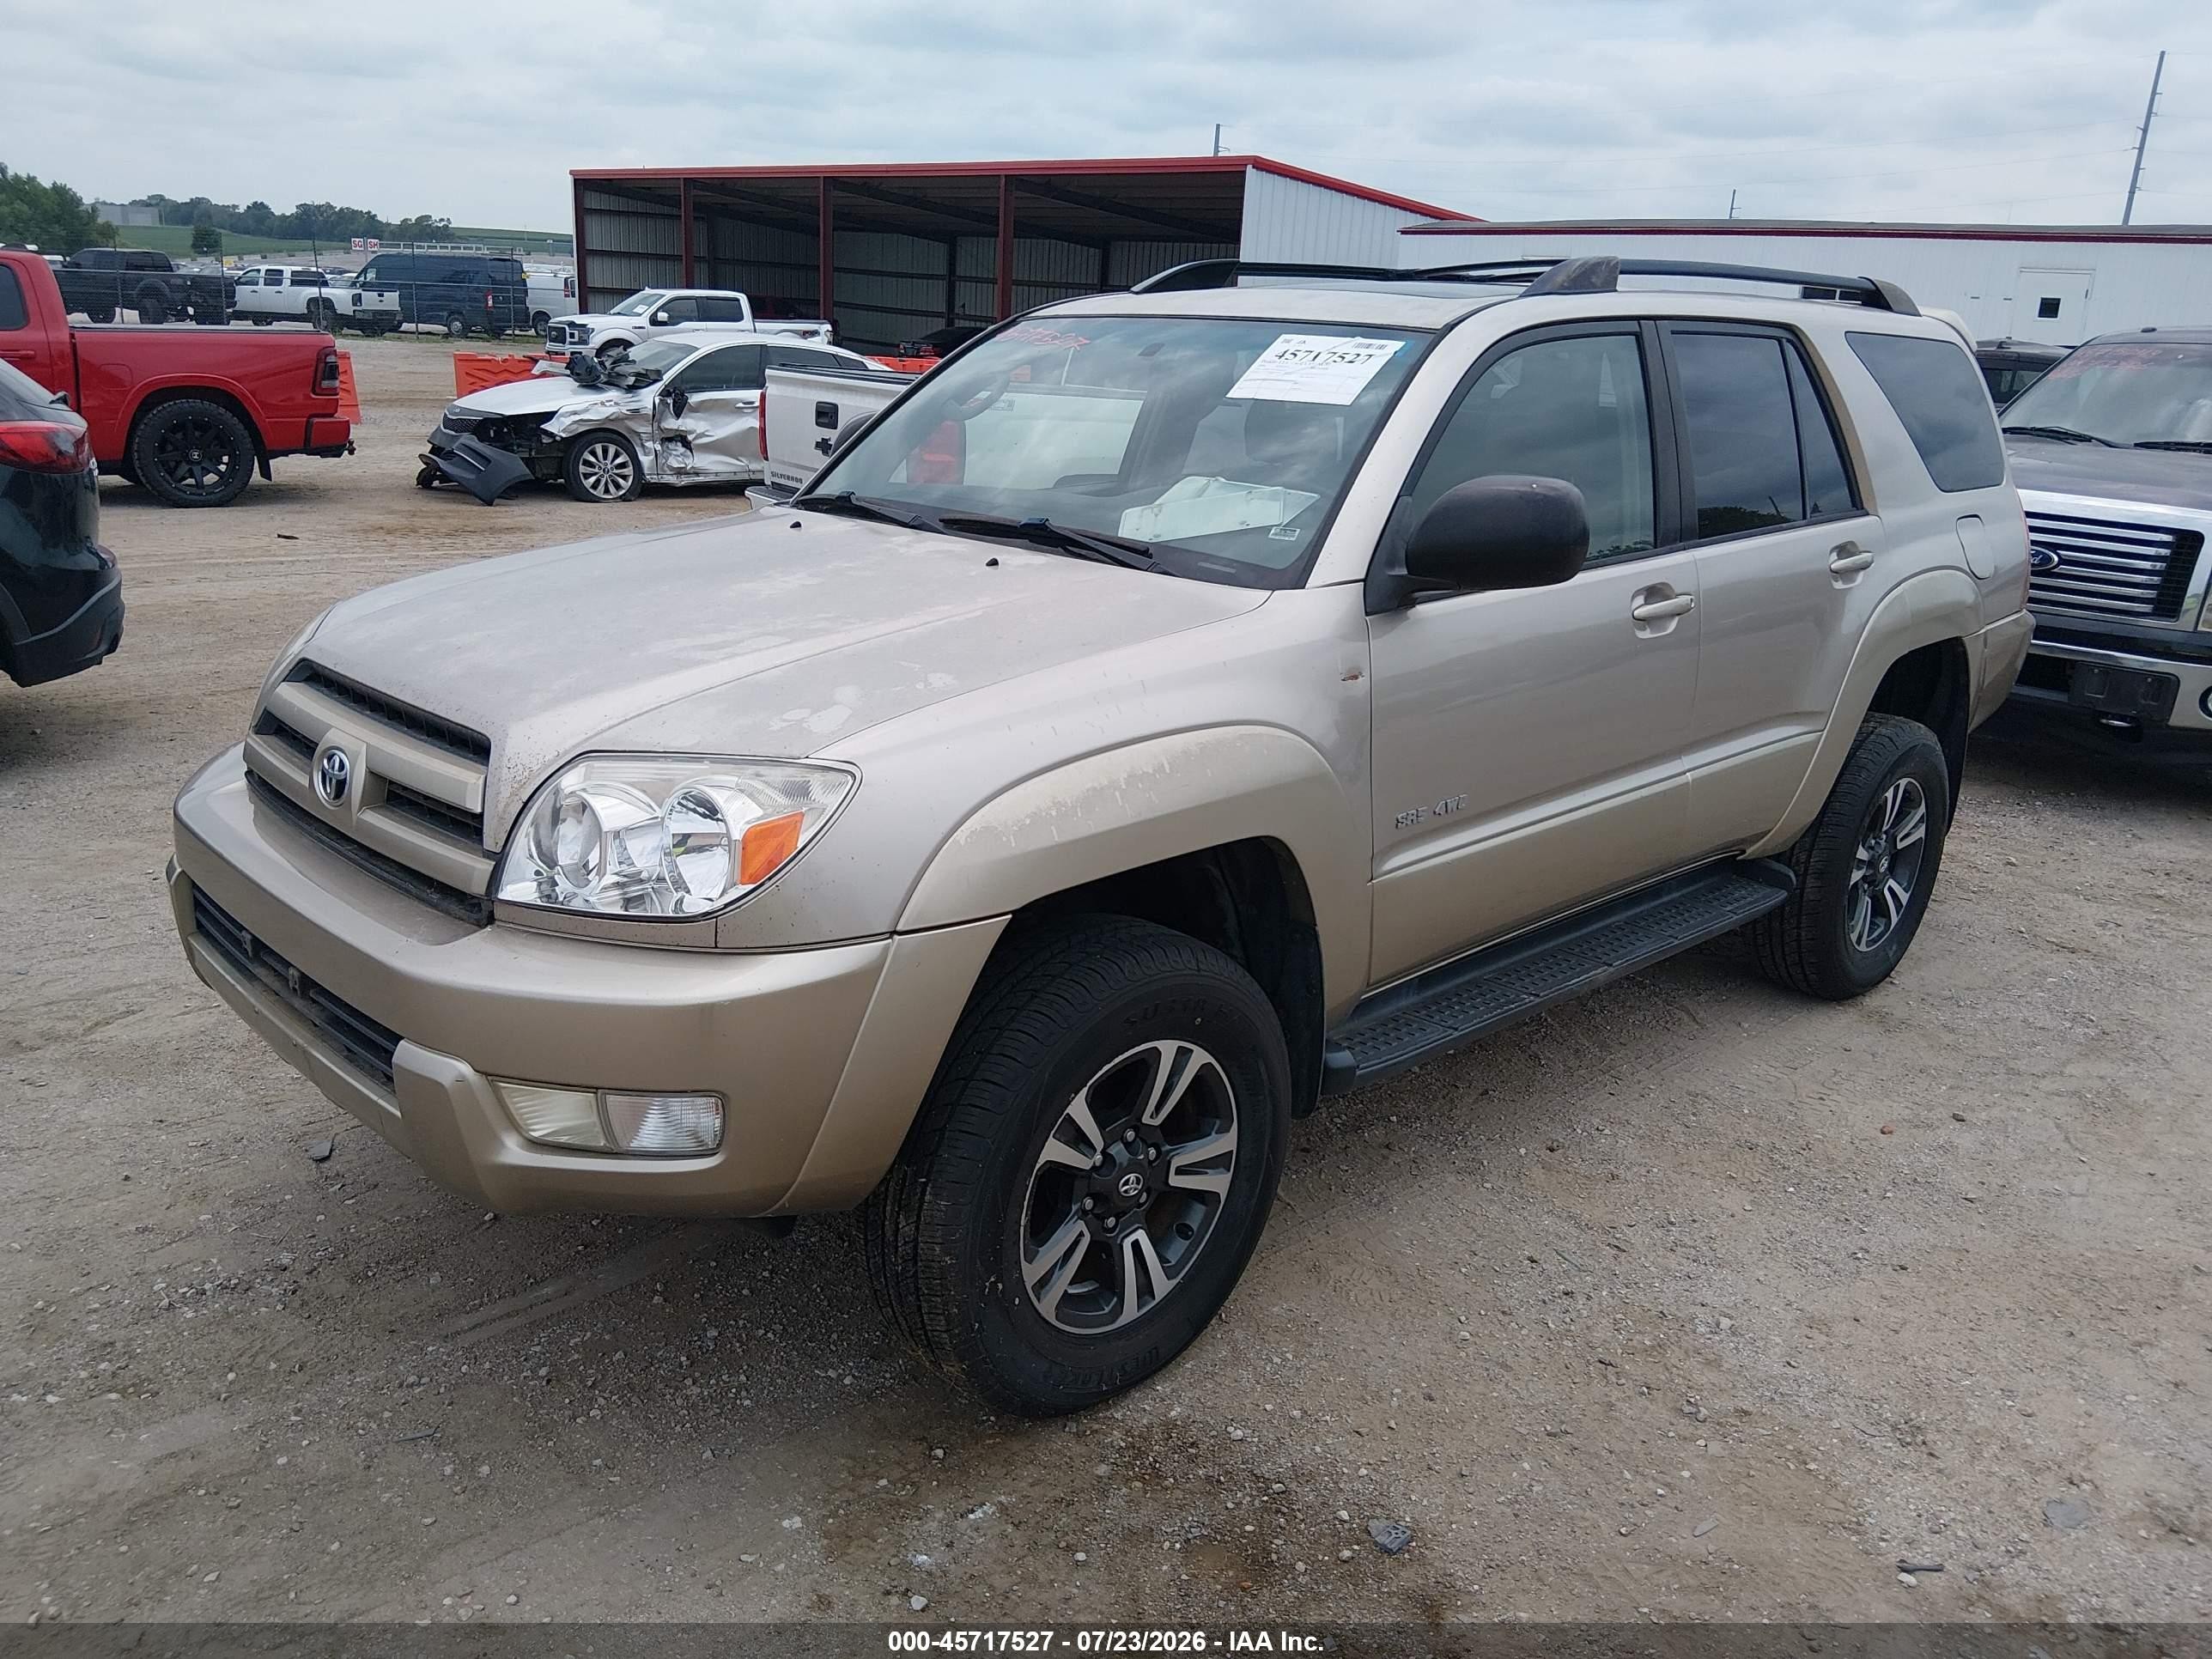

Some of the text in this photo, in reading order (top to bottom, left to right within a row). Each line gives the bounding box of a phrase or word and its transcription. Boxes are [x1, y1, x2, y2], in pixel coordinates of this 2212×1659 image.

[352, 240, 363, 248] SG
[368, 240, 379, 249] SH
[1275, 349, 1375, 365] 45717527
[770, 471, 804, 485] SILVERADO
